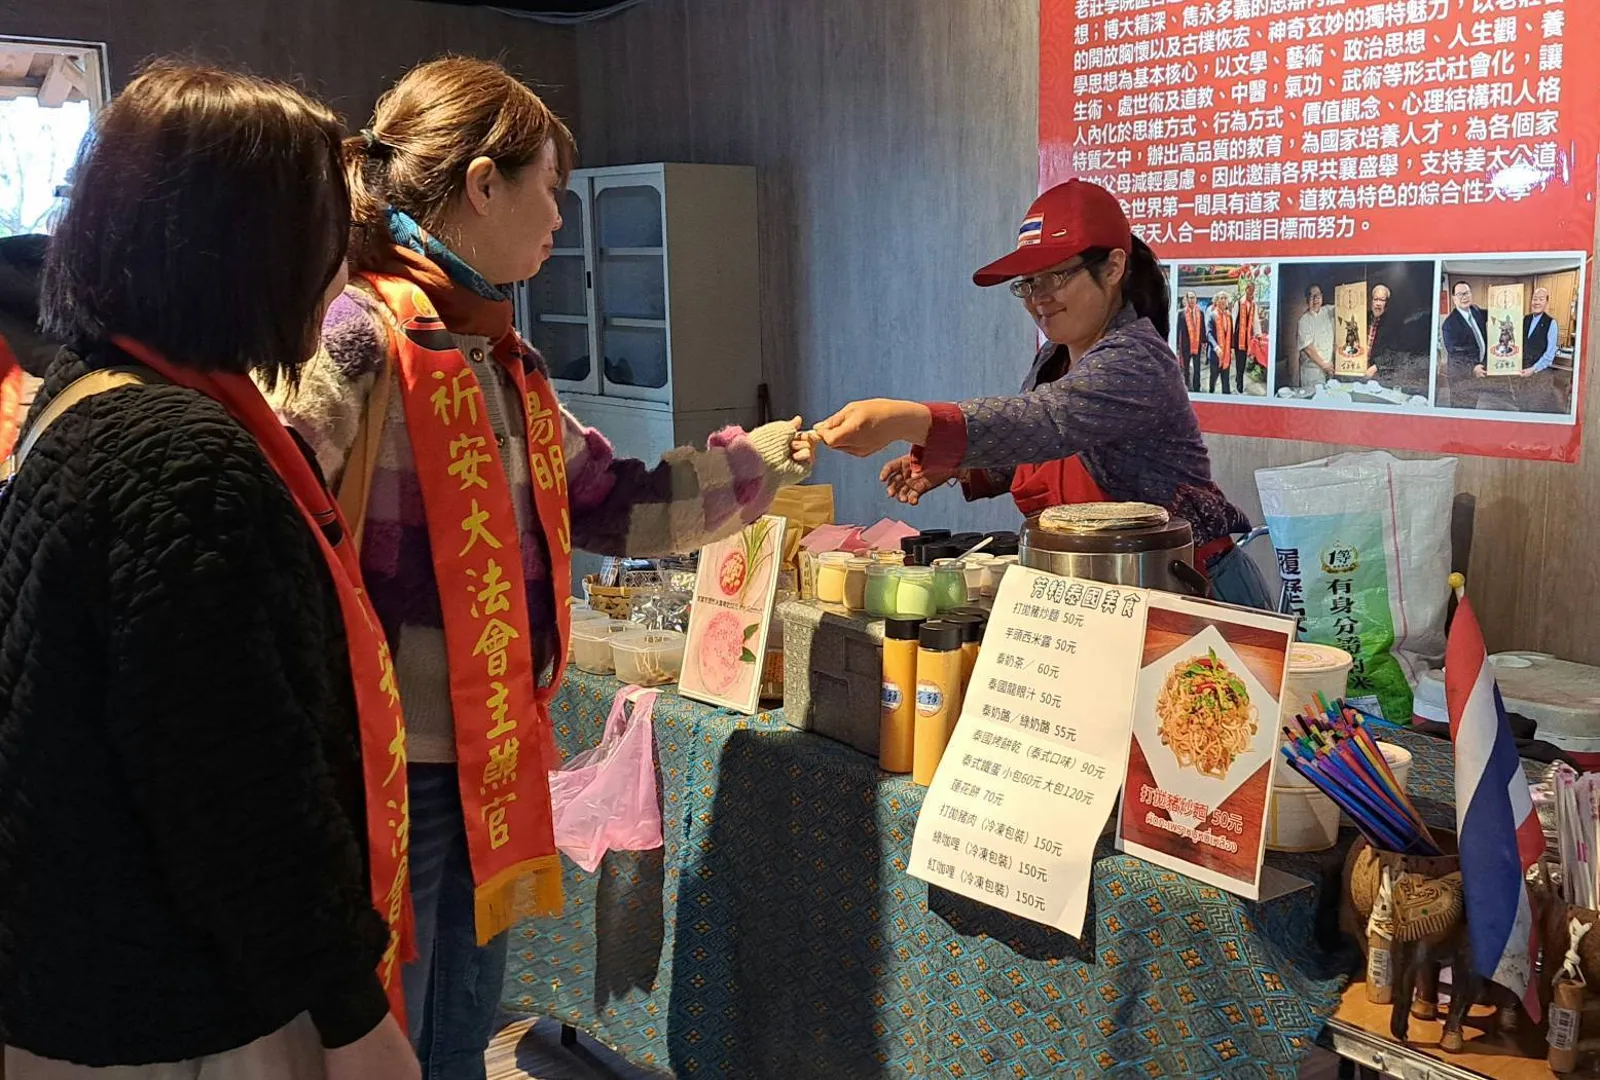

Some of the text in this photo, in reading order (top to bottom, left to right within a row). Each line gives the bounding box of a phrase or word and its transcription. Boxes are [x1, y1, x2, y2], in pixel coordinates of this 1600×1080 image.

[1062, 612, 1085, 628] 50元
[1005, 627, 1077, 655] 芋頭西米露 50元
[1037, 663, 1060, 679] 60元
[988, 678, 1062, 708] 泰國龍眼汁 50元
[1054, 725, 1077, 742] 55元
[983, 790, 1004, 806] 70元
[1210, 809, 1244, 834] 50元
